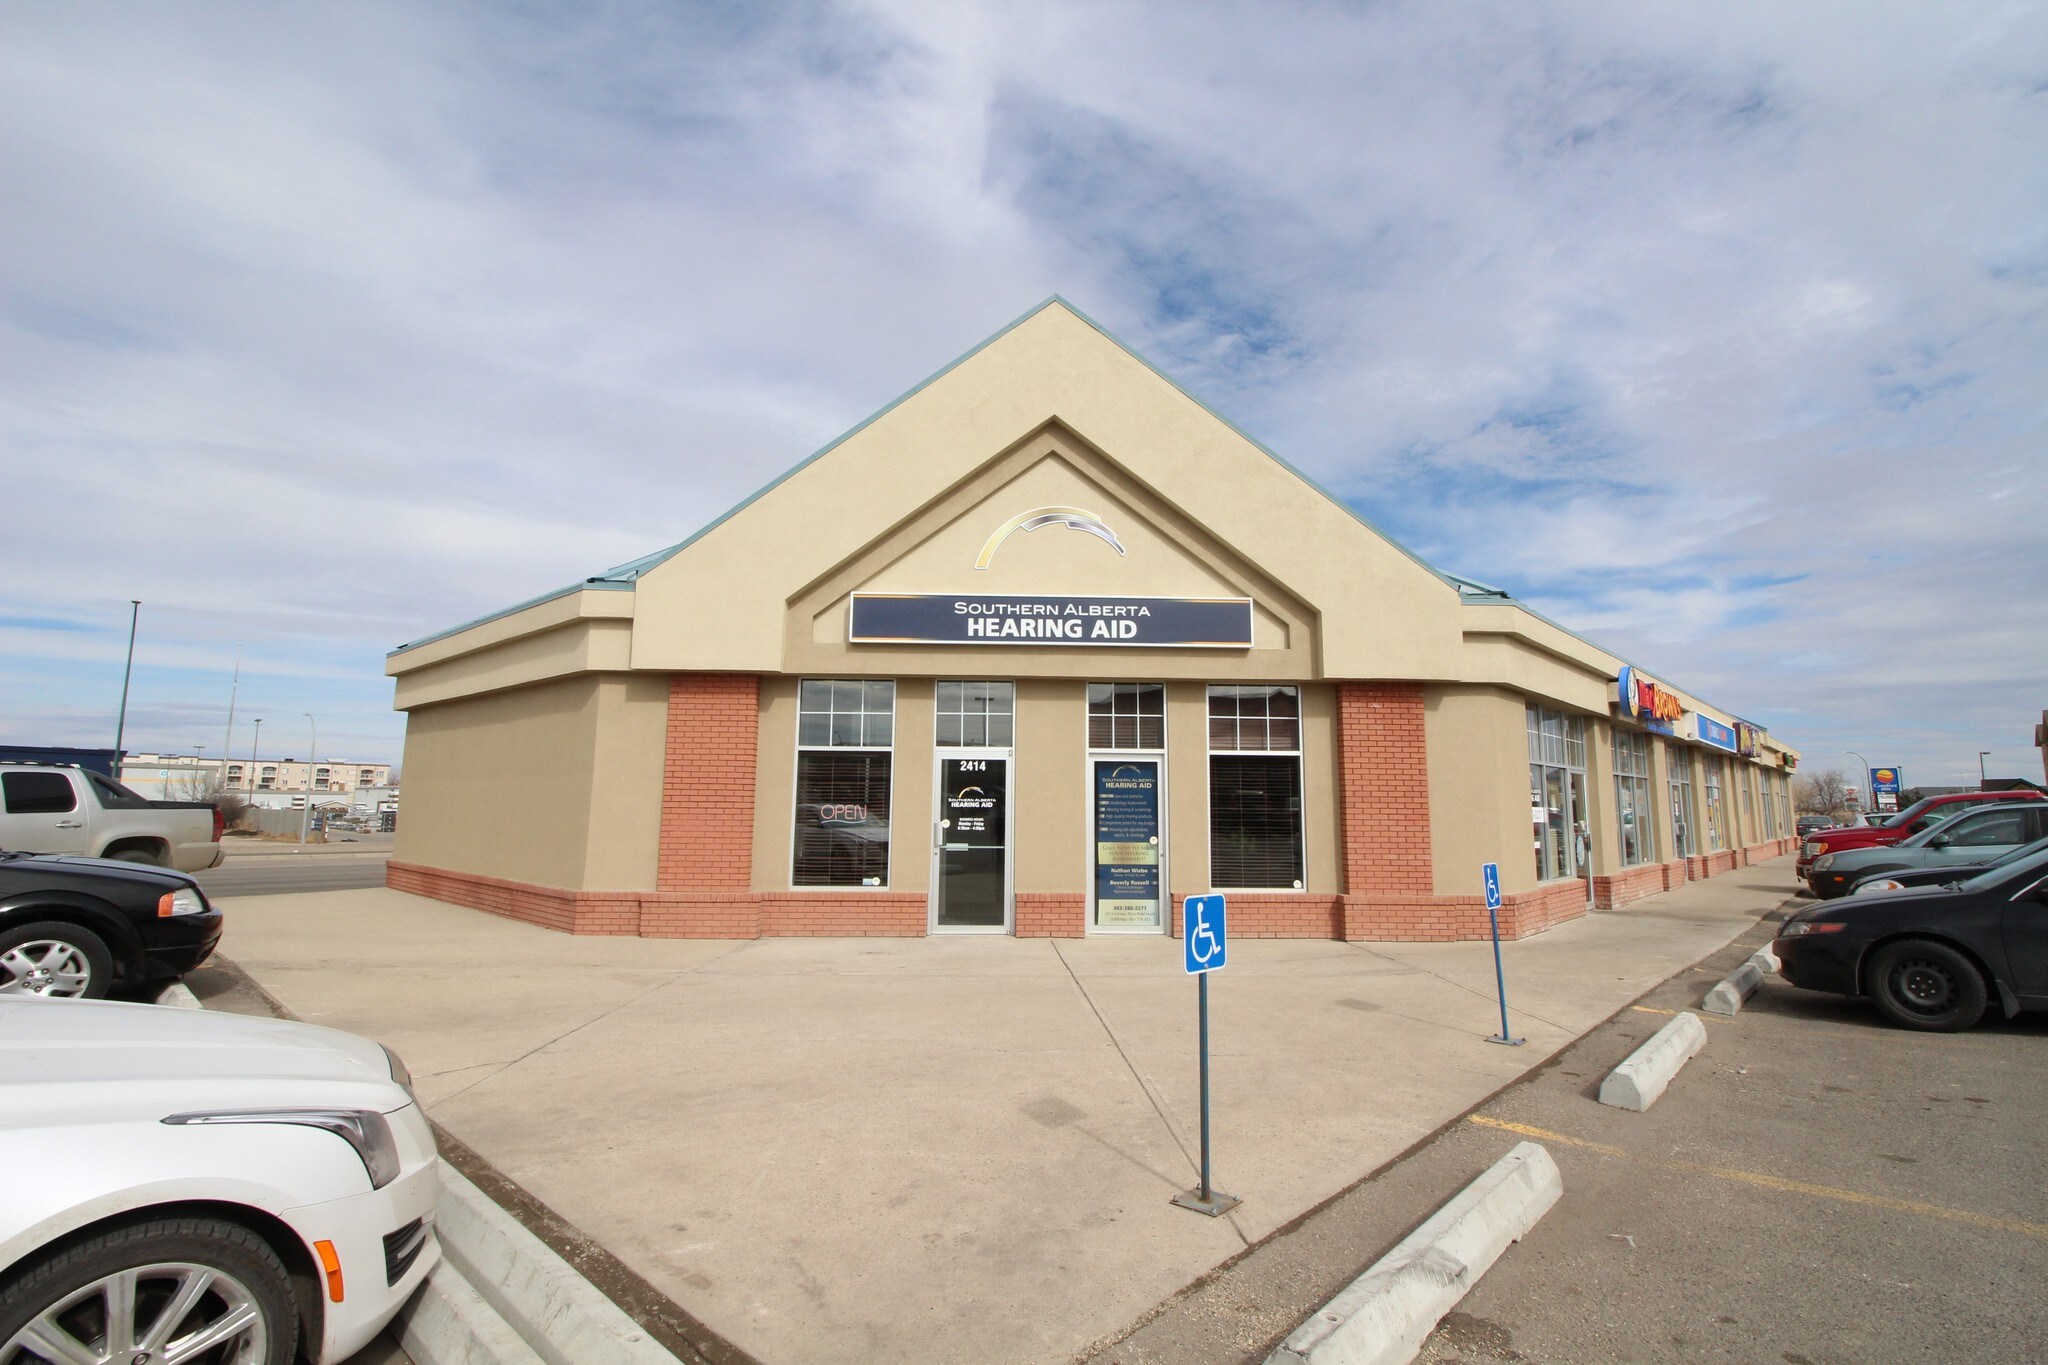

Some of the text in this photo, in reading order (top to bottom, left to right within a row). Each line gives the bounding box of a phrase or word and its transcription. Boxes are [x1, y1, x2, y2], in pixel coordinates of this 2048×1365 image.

[954, 602, 1151, 617] SOUTHERN ALBERTA
[967, 618, 1138, 639] HEARING AID
[960, 760, 986, 771] 2414
[820, 804, 867, 820] OPEN
